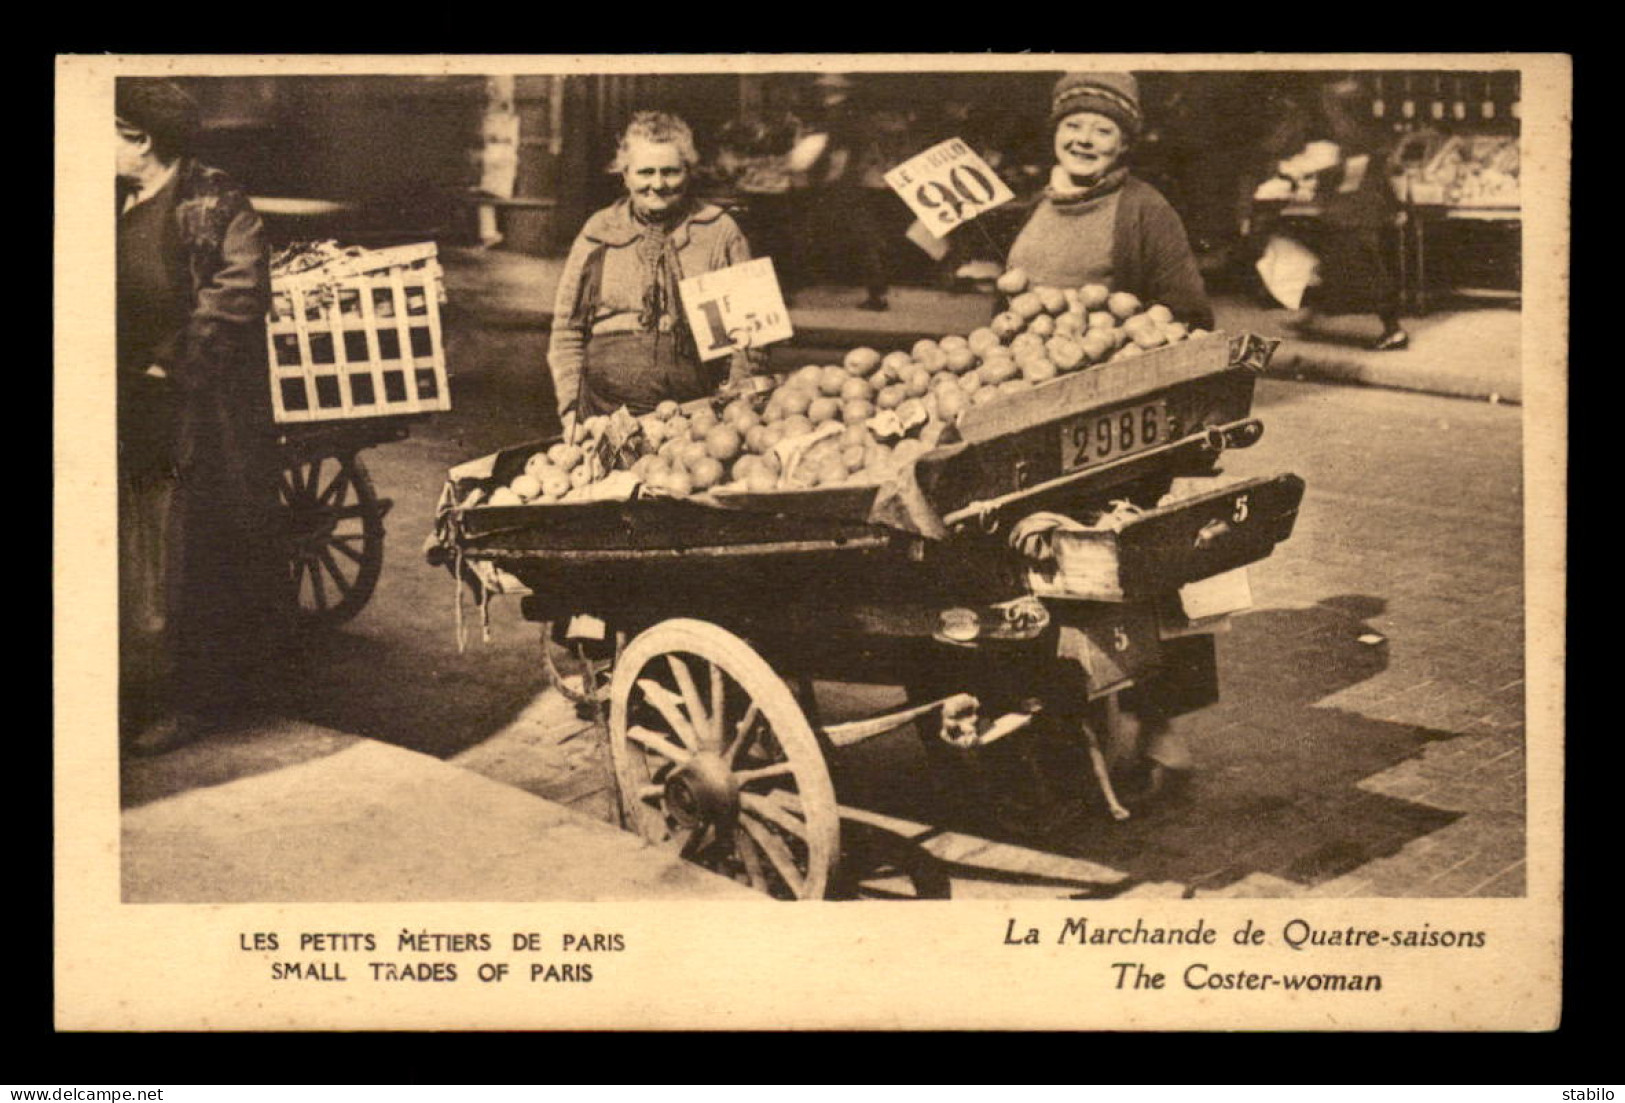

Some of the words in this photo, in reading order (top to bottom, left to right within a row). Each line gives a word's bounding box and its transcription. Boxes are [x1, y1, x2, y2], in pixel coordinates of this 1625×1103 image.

[916, 164, 995, 223] 90
[1073, 406, 1159, 467] 2986
[1232, 495, 1249, 524] 5
[1114, 627, 1130, 652] 5
[240, 932, 279, 951] LES
[300, 932, 376, 951] PETITS
[398, 929, 491, 952] MÉTIERS
[513, 932, 540, 951] DE
[563, 933, 625, 952] PARIS
[1003, 918, 1040, 945] La
[1057, 917, 1216, 945] Marchande
[1233, 919, 1266, 945] de
[1283, 918, 1486, 951] Quatre-saisons
[271, 962, 346, 981] SMALL
[369, 962, 458, 983] TRADES
[478, 963, 509, 983] OF
[531, 963, 593, 983] PARIS
[1111, 962, 1166, 990] The
[1183, 963, 1382, 991] Coster-woman
